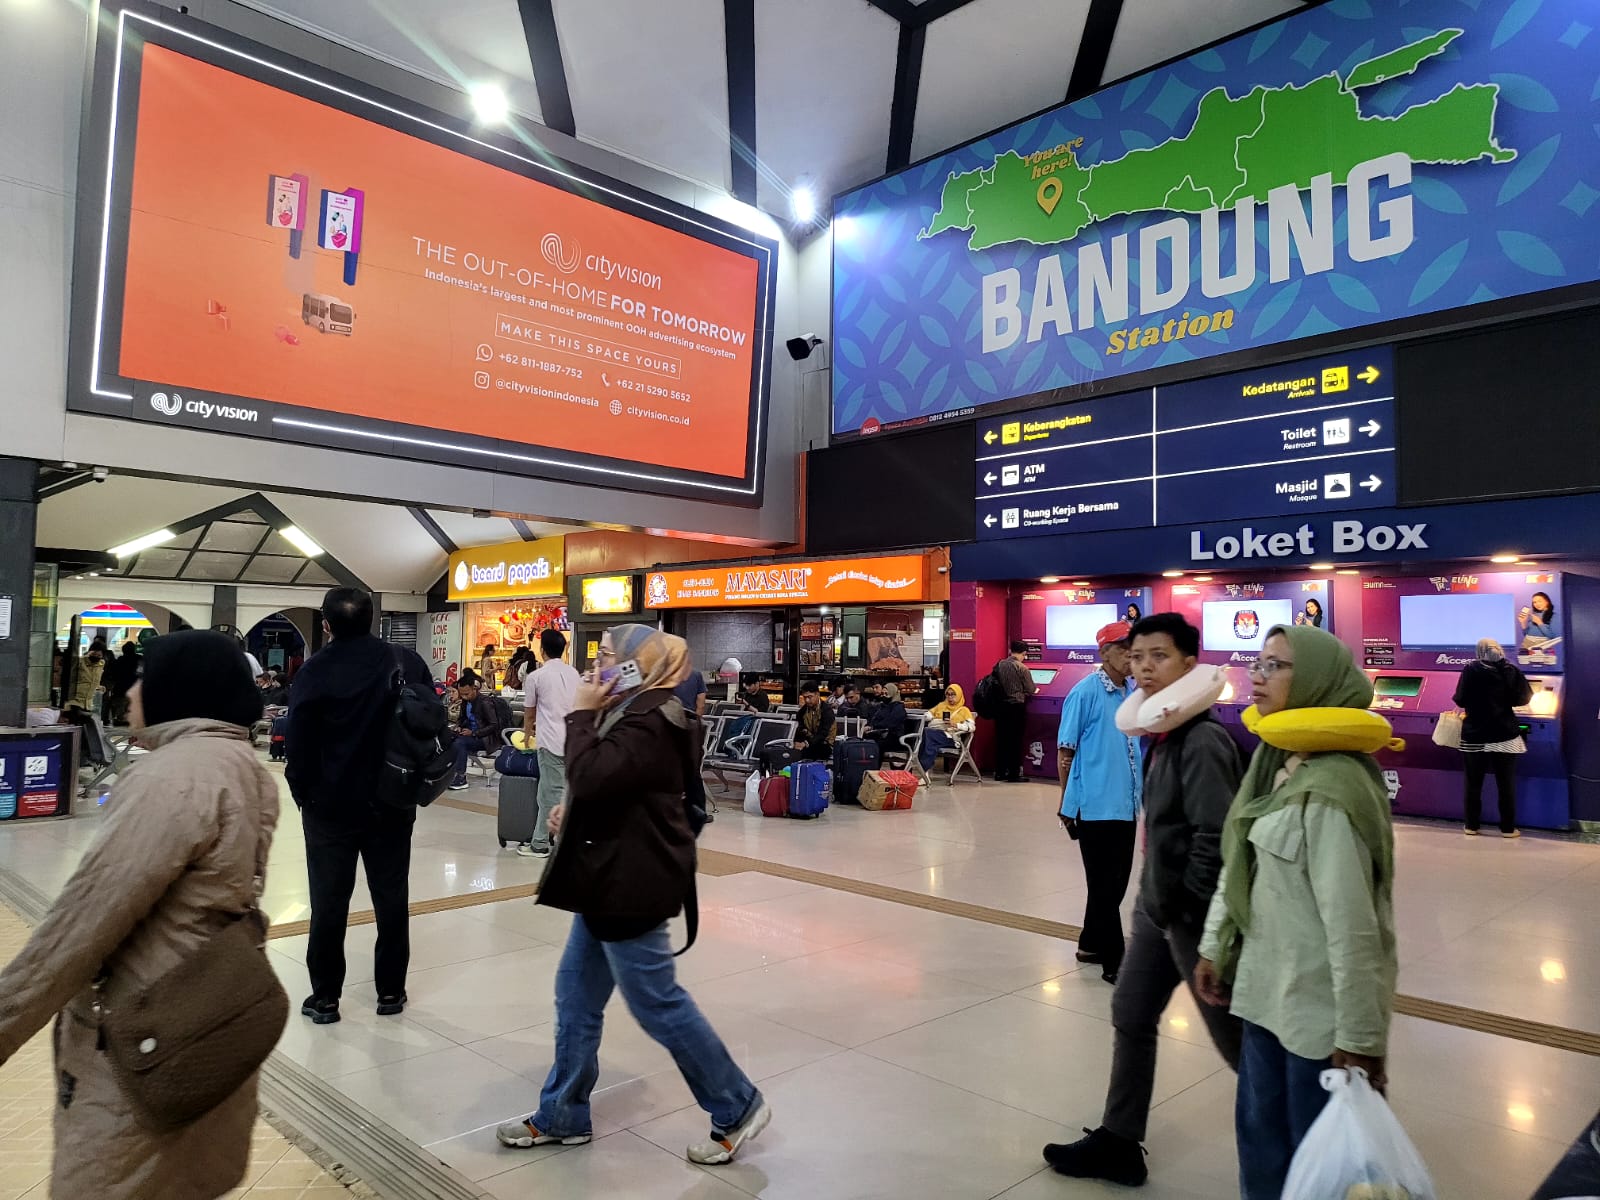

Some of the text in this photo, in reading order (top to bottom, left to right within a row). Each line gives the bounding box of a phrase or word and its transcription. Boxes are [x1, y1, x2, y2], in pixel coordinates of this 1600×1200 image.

[1024, 136, 1084, 167] You are
[1031, 152, 1074, 180] here!
[982, 152, 1414, 354] BANDUNG
[585, 254, 662, 291] cityvision
[412, 236, 746, 346] THE OUT-OF-HOME FOR TOMORROW
[425, 268, 736, 360] Indonesia's largest and most prominent OOH advertising ecosystem
[1105, 308, 1235, 356] Station
[500, 321, 678, 374] MAKE THIS SPACE YOURS
[499, 352, 583, 379] +62 811-1887-752
[495, 378, 599, 408] @cityvisionindonesia
[616, 378, 691, 402] +62 21 5290 5652
[1242, 376, 1316, 397] Kedatangan
[627, 405, 690, 426] cityvision.co.id
[1023, 414, 1092, 433] Keberangkatan
[1281, 427, 1317, 441] Toilet
[1283, 441, 1316, 450] Restroom
[1023, 463, 1045, 475] ATM
[1275, 479, 1318, 494] Masjid
[1289, 494, 1317, 503] Mosque
[1023, 502, 1119, 519] Ruang Kerja Bersama
[1190, 520, 1429, 561] Loket Box
[471, 557, 550, 586] beard papa's
[725, 569, 808, 593] MAYASARI
[433, 624, 448, 635] LOVE
[1067, 651, 1094, 660] Access
[1229, 651, 1258, 662] Acces
